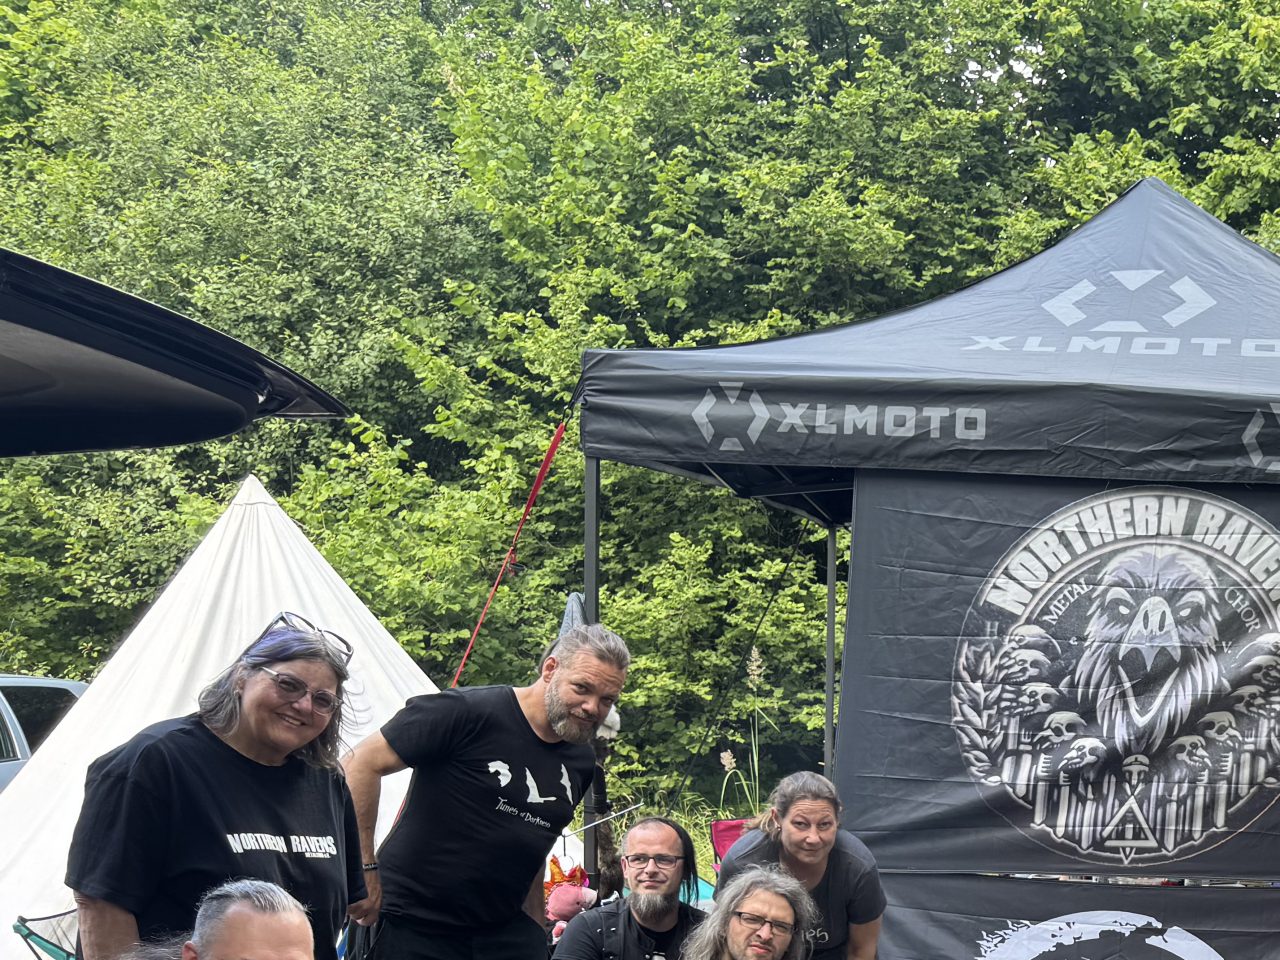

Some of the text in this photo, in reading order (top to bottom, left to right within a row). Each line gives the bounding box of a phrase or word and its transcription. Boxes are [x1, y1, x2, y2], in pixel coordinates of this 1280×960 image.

[775, 402, 987, 441] XLMOTO
[984, 498, 1192, 615] NORTHERN
[1042, 578, 1094, 626] METAL
[1224, 586, 1261, 633] CHOR
[290, 835, 337, 855] RAVENS
